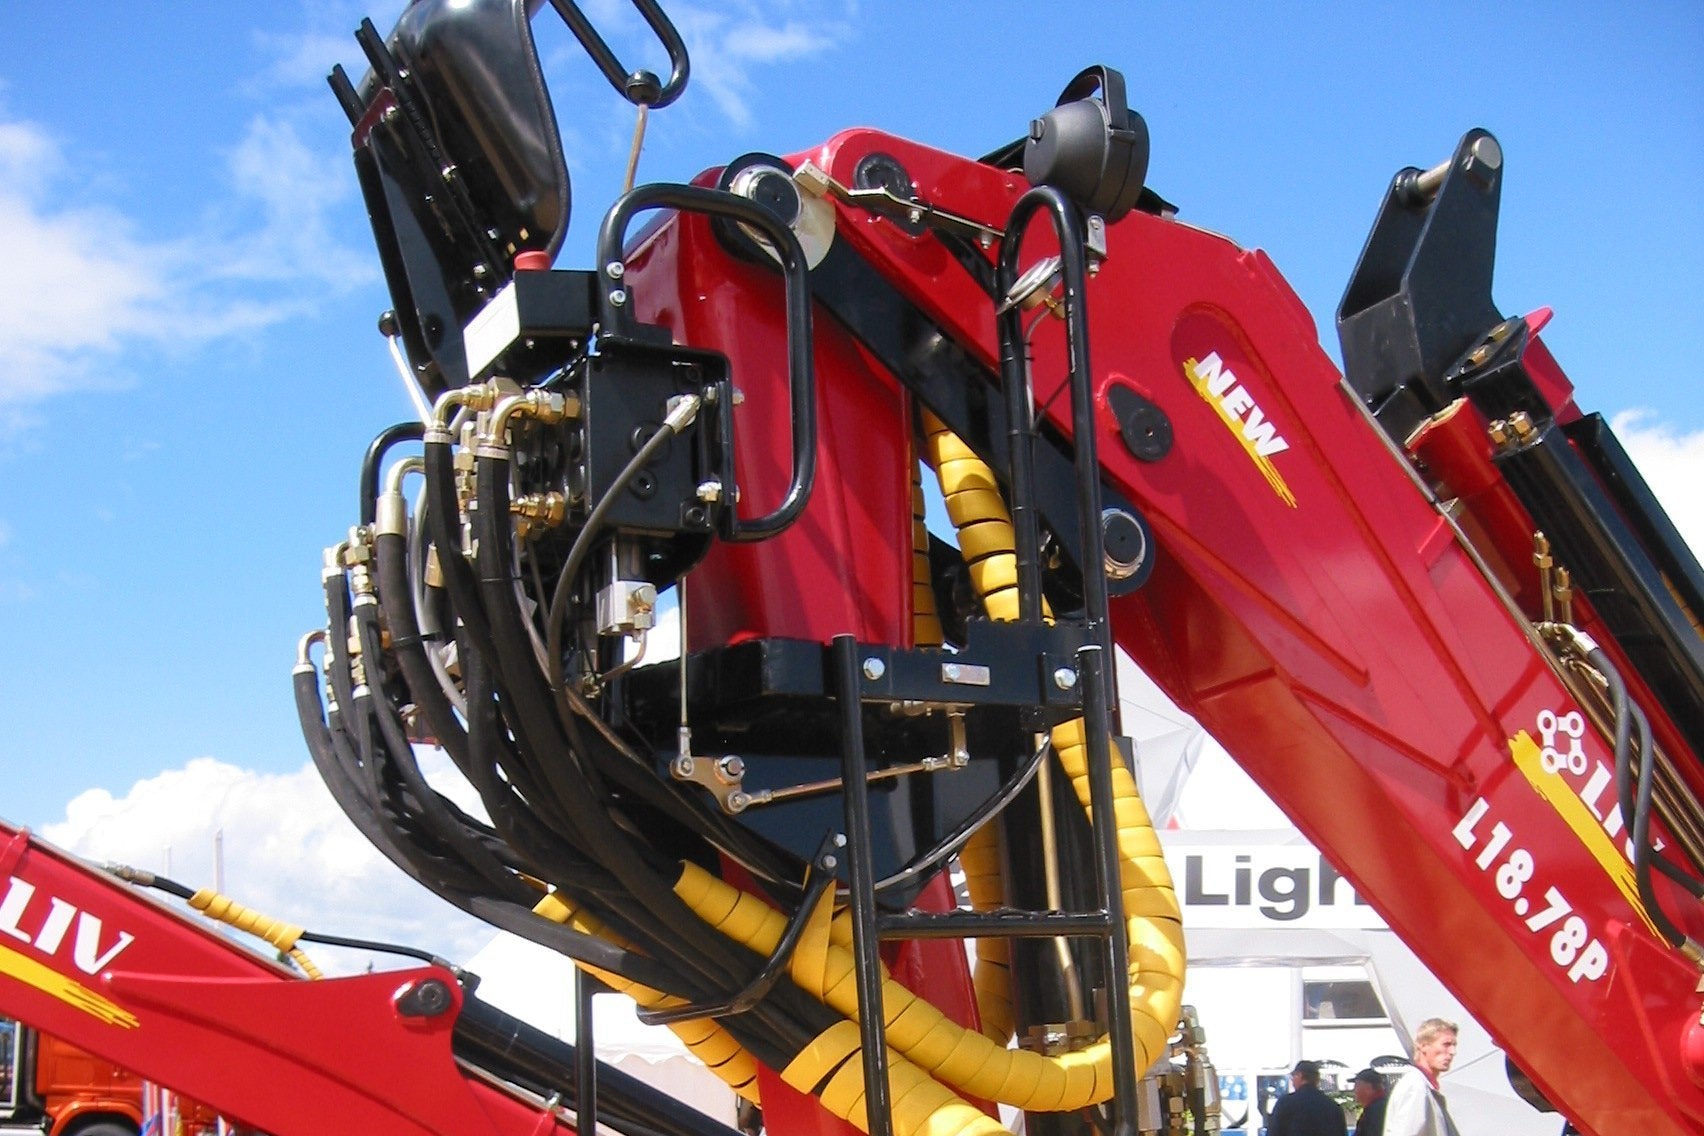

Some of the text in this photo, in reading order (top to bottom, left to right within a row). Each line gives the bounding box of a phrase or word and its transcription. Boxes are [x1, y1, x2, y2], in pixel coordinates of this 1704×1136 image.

[1193, 351, 1290, 457] NEW
[1579, 759, 1666, 866] LI
[0, 876, 136, 976] LIV
[1452, 797, 1608, 984] L18.78P
